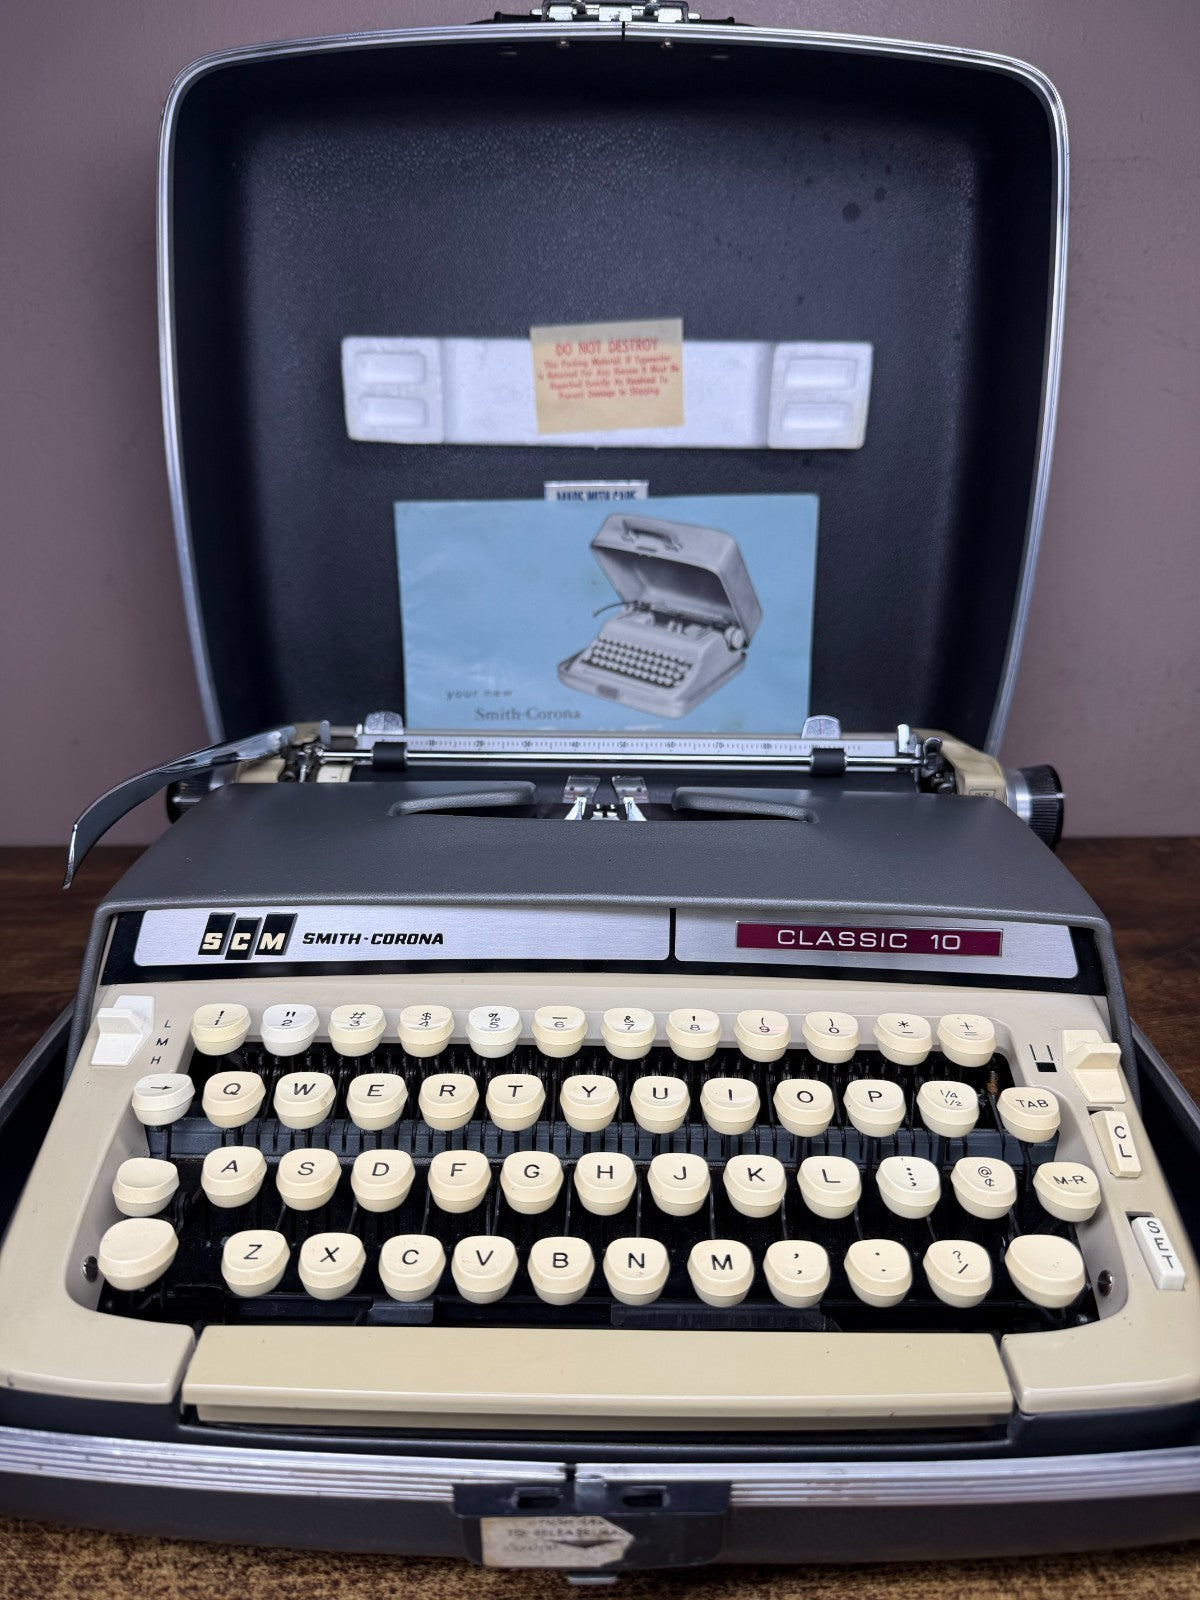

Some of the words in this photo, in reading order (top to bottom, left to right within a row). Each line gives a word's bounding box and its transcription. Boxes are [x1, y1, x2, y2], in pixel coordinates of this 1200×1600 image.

[555, 342, 573, 357] DO
[578, 340, 602, 355] NOT
[608, 337, 659, 354] DESTROY
[446, 690, 478, 701] your
[483, 690, 512, 698] new
[474, 707, 581, 721] Smith-Corona
[777, 929, 908, 949] CLASSIC
[930, 934, 961, 950] 10
[349, 1011, 367, 1020] #
[421, 1011, 432, 1021] $
[488, 1012, 501, 1022] %
[623, 1015, 635, 1024] &
[164, 1019, 172, 1028] L
[281, 1019, 294, 1027] 2
[489, 1021, 500, 1029] 5
[758, 1025, 771, 1033] 9
[156, 1037, 169, 1047] M
[150, 1056, 162, 1065] H
[223, 1082, 241, 1096] Q
[293, 1082, 317, 1096] W
[366, 1084, 385, 1097] E
[438, 1084, 456, 1097] R
[507, 1084, 524, 1097] T
[581, 1085, 597, 1098] Y
[652, 1087, 668, 1100] U
[728, 1088, 733, 1101] I
[796, 1090, 814, 1103] O
[867, 1090, 883, 1103] P
[1015, 1098, 1049, 1109] TAB
[220, 1159, 239, 1173] A
[297, 1161, 315, 1176] S
[371, 1162, 390, 1177] D
[450, 1162, 467, 1177] F
[523, 1164, 540, 1179] G
[596, 1164, 614, 1179] H
[977, 1166, 992, 1178] @
[673, 1166, 687, 1180] J
[747, 1167, 765, 1182] K
[821, 1168, 841, 1184] L
[1052, 1174, 1087, 1185] M-R
[1146, 1220, 1174, 1269] SET
[243, 1244, 263, 1260] Z
[319, 1246, 340, 1263] X
[401, 1249, 419, 1265] C
[476, 1250, 494, 1266] V
[552, 1252, 569, 1268] B
[628, 1252, 645, 1269] N
[710, 1254, 734, 1270] M
